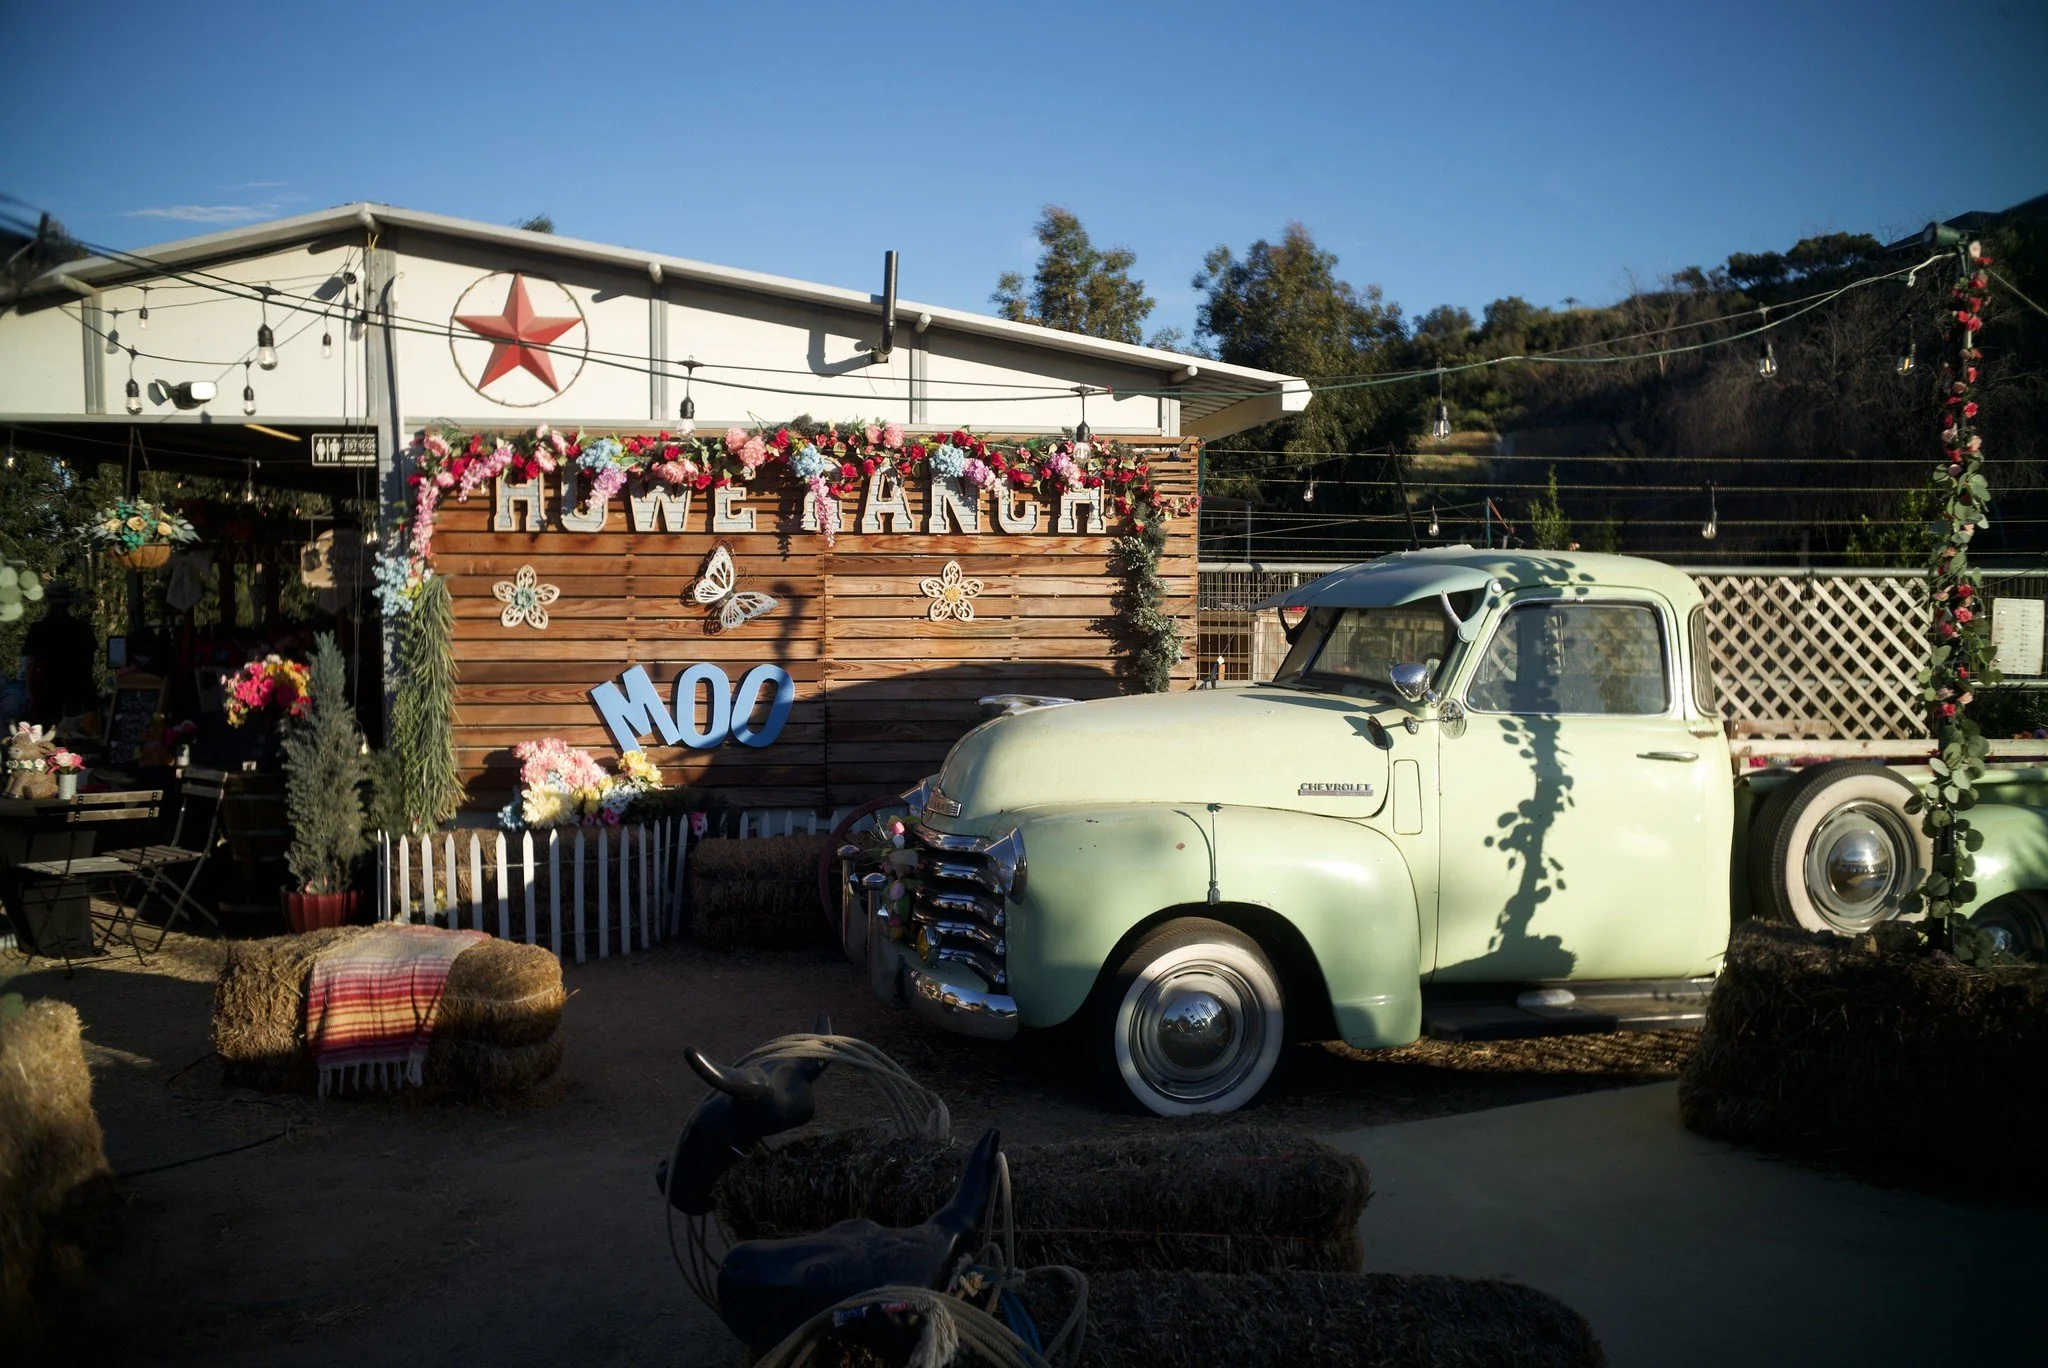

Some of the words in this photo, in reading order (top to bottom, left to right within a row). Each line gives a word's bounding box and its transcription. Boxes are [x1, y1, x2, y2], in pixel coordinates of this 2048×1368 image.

[494, 460, 757, 532] HOWE
[800, 455, 1107, 533] RANCH
[591, 663, 796, 752] MOO
[1300, 782, 1372, 791] CHEVROLET
